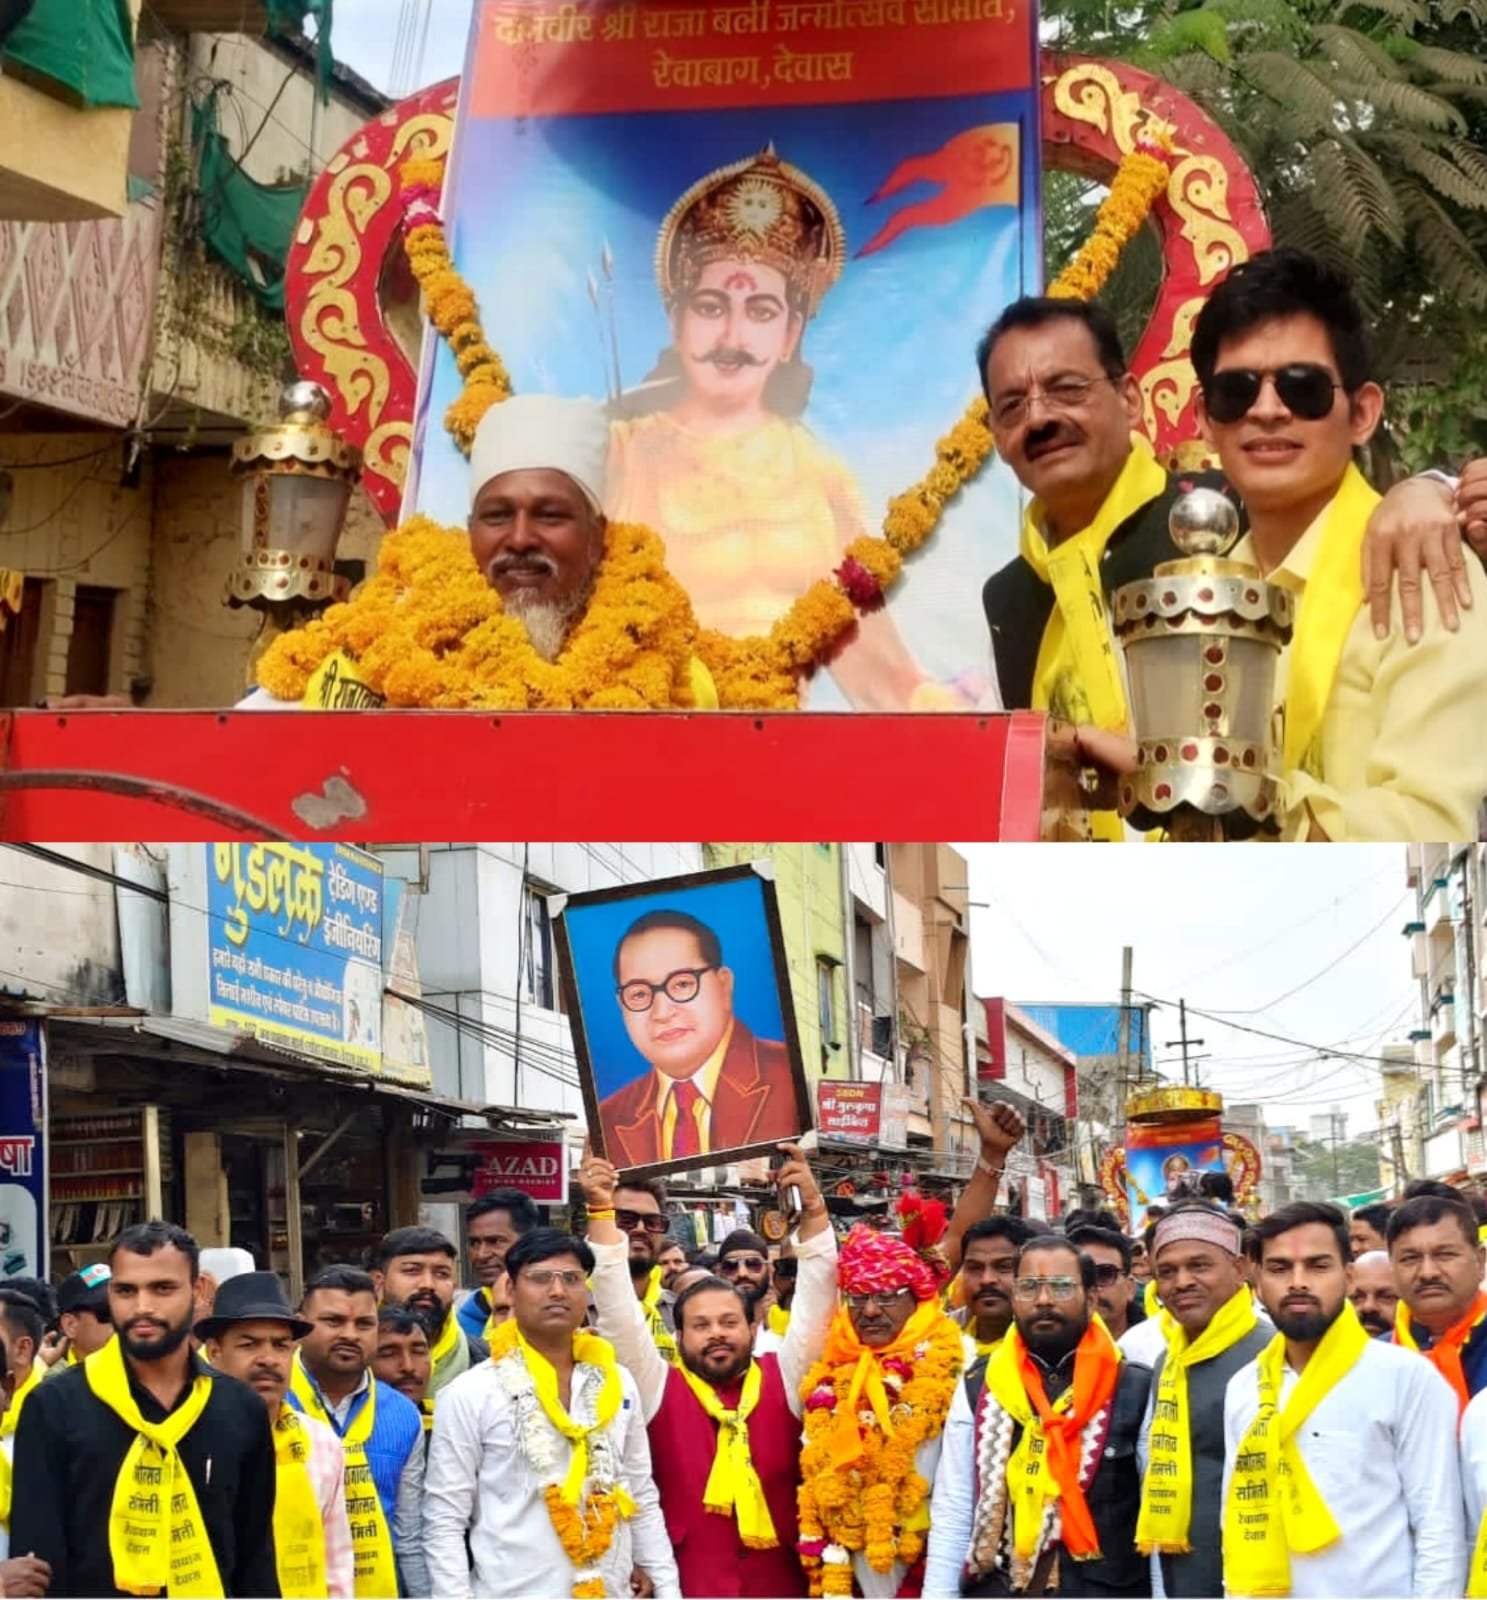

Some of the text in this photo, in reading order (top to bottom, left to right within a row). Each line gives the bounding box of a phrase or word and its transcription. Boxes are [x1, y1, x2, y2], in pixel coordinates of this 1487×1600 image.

[602, 2, 637, 42] श्री
[643, 9, 706, 38] राजा
[486, 1156, 559, 1177] AZAD
